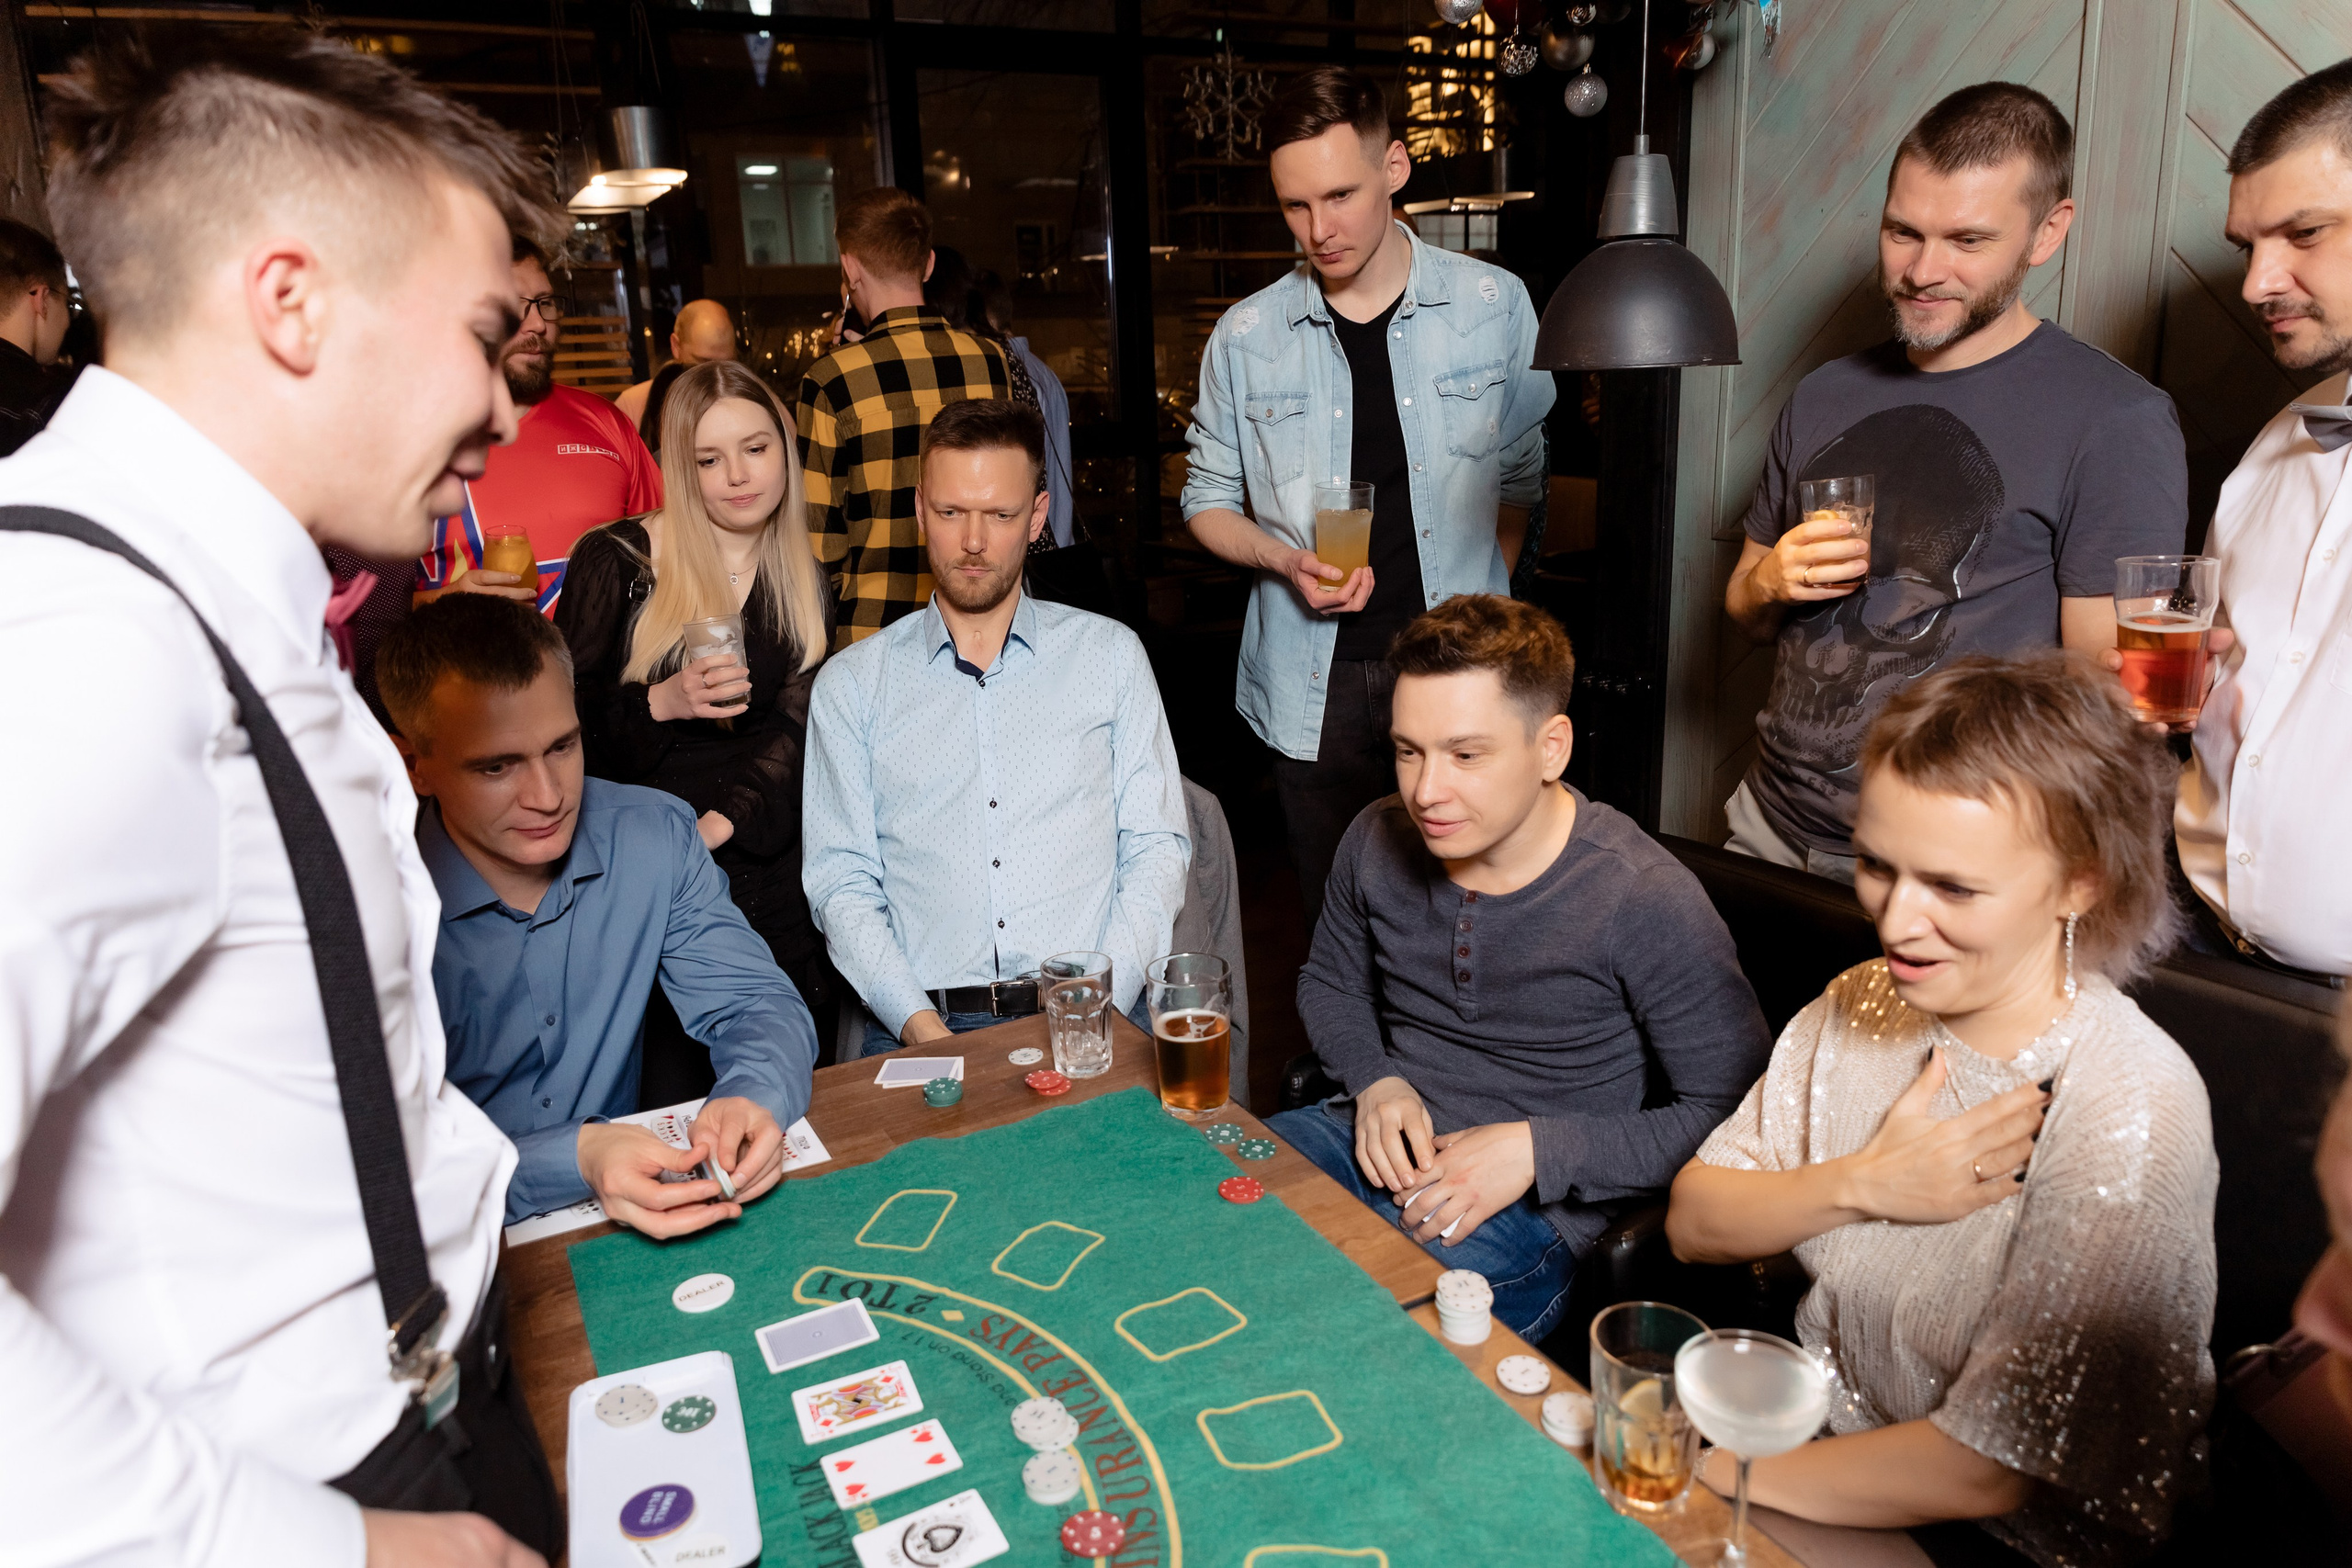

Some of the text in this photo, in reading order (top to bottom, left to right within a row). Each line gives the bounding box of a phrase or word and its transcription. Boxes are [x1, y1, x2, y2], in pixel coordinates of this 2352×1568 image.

[678, 1280, 725, 1302] DEALER
[817, 1272, 840, 1295] 1
[840, 1279, 901, 1310] TO
[904, 1293, 939, 1314] 2
[900, 1331, 925, 1347] 17
[927, 1340, 951, 1354] on
[968, 1314, 1065, 1373] PAYS
[639, 1490, 664, 1526] BLIND
[652, 1490, 678, 1525] SMALL
[803, 1507, 862, 1568] LACK
